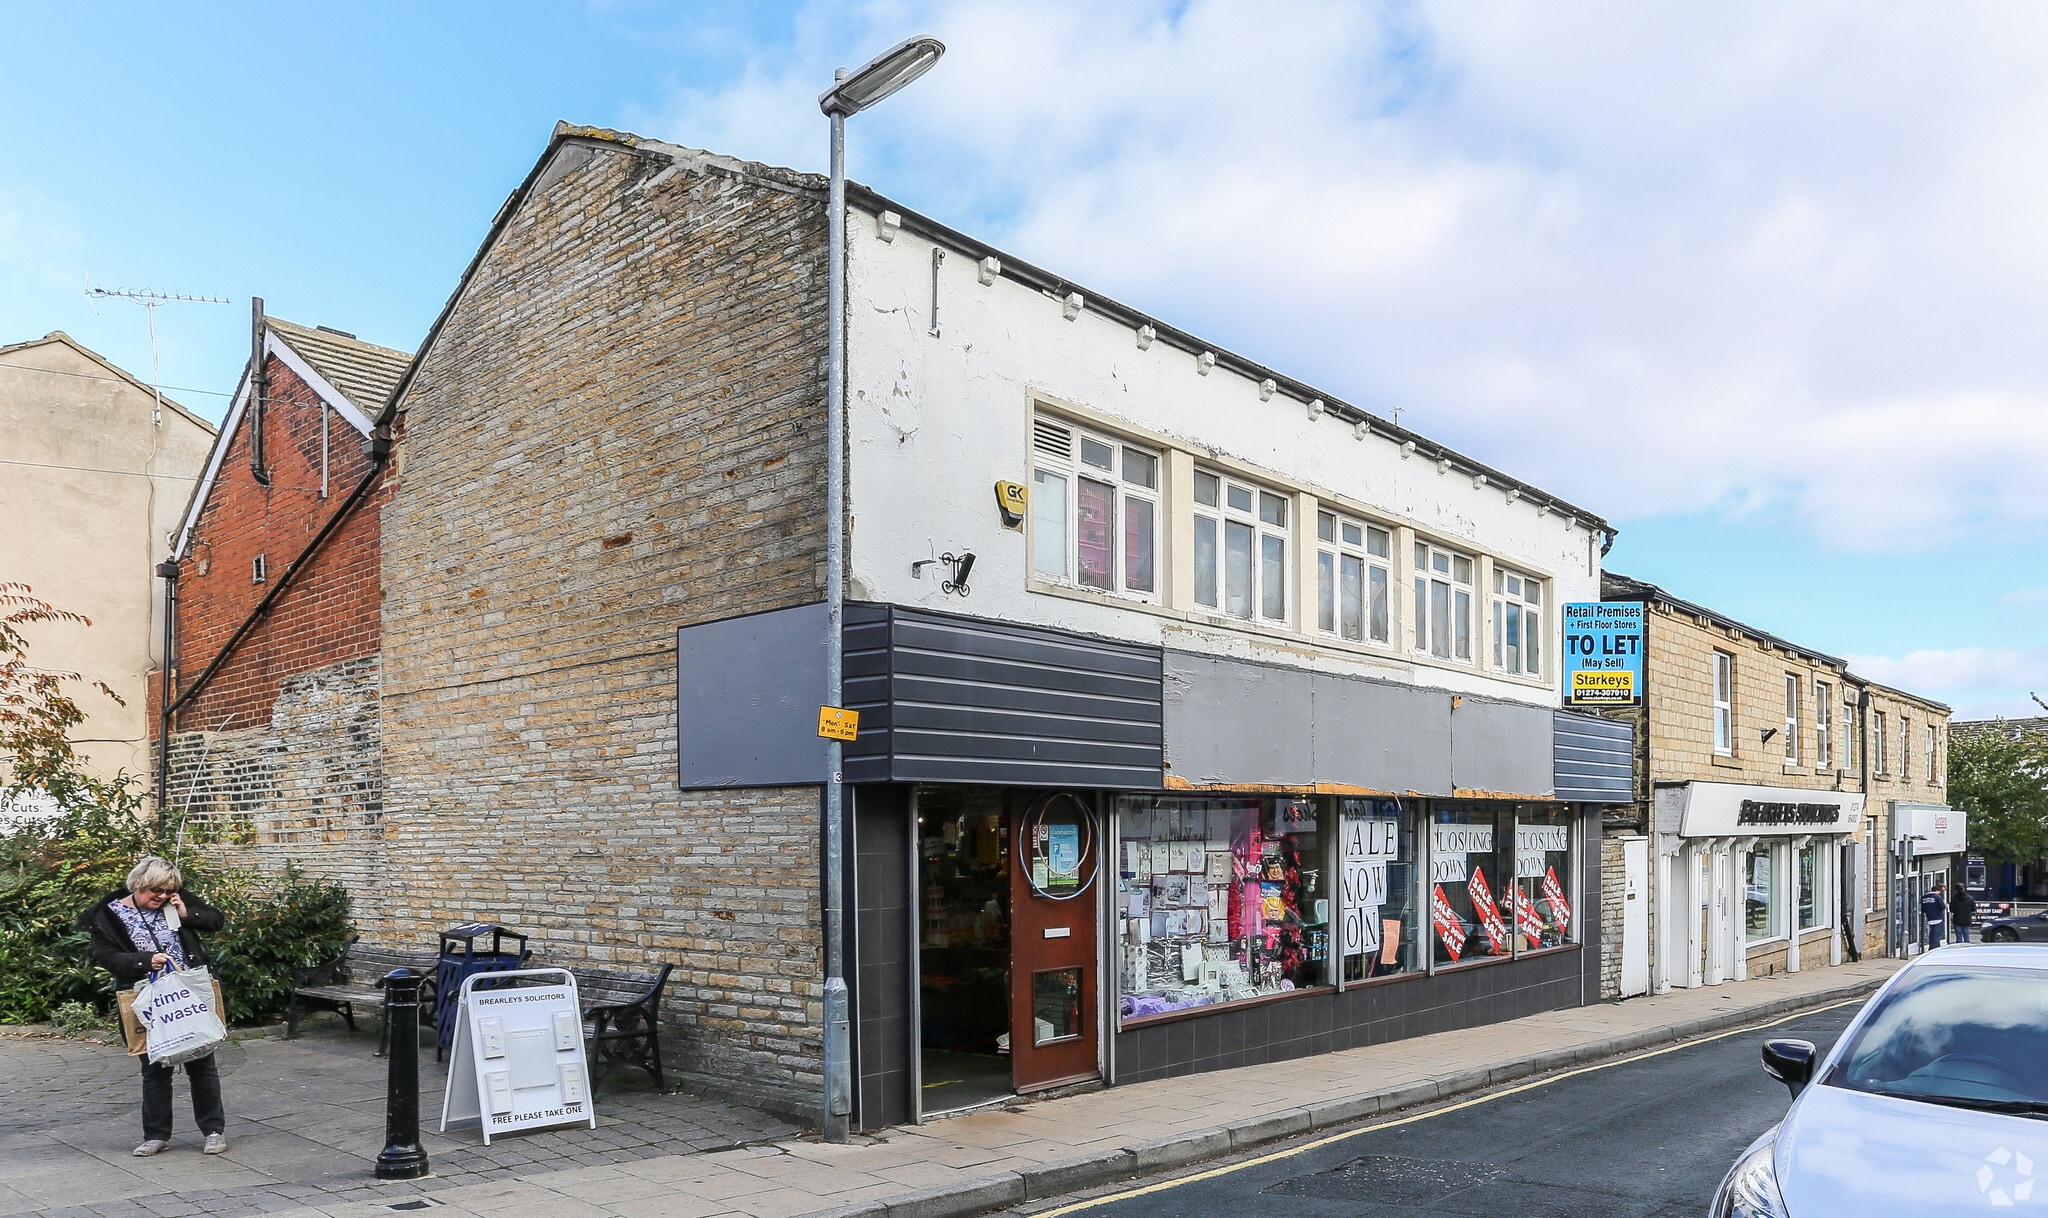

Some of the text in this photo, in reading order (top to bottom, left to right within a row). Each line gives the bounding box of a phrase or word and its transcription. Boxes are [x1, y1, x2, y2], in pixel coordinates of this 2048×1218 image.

[1007, 485, 1024, 500] GK
[1566, 605, 1640, 618] Retail Premises
[1577, 620, 1592, 629] First
[1595, 620, 1612, 629] Floor
[1614, 620, 1636, 629] Stores
[1566, 635, 1640, 655] TO LET
[1582, 658, 1624, 669] (May Sell)
[1576, 674, 1630, 688] Starkeys
[836, 773, 841, 782] 3
[12, 804, 42, 812] Cuts:
[1345, 821, 1397, 857] ALE
[1472, 877, 1492, 906] SALE
[1546, 875, 1561, 896] SALE
[1434, 895, 1452, 919] SALE
[1470, 888, 1507, 934] CLOSING DOWN
[1529, 915, 1543, 928] DOWN
[1553, 907, 1569, 928] SALE
[1346, 912, 1377, 948] ON
[1451, 927, 1466, 943] DOWN
[1484, 918, 1503, 944] SALE
[1523, 921, 1541, 939] SALE
[1442, 931, 1462, 954] SALE
[153, 989, 191, 1008] time
[479, 993, 566, 1006] BREARLEYS SOLICITORS
[160, 1003, 208, 1024] waste
[493, 1106, 582, 1125] FREE PLEASE TAKE ONE
